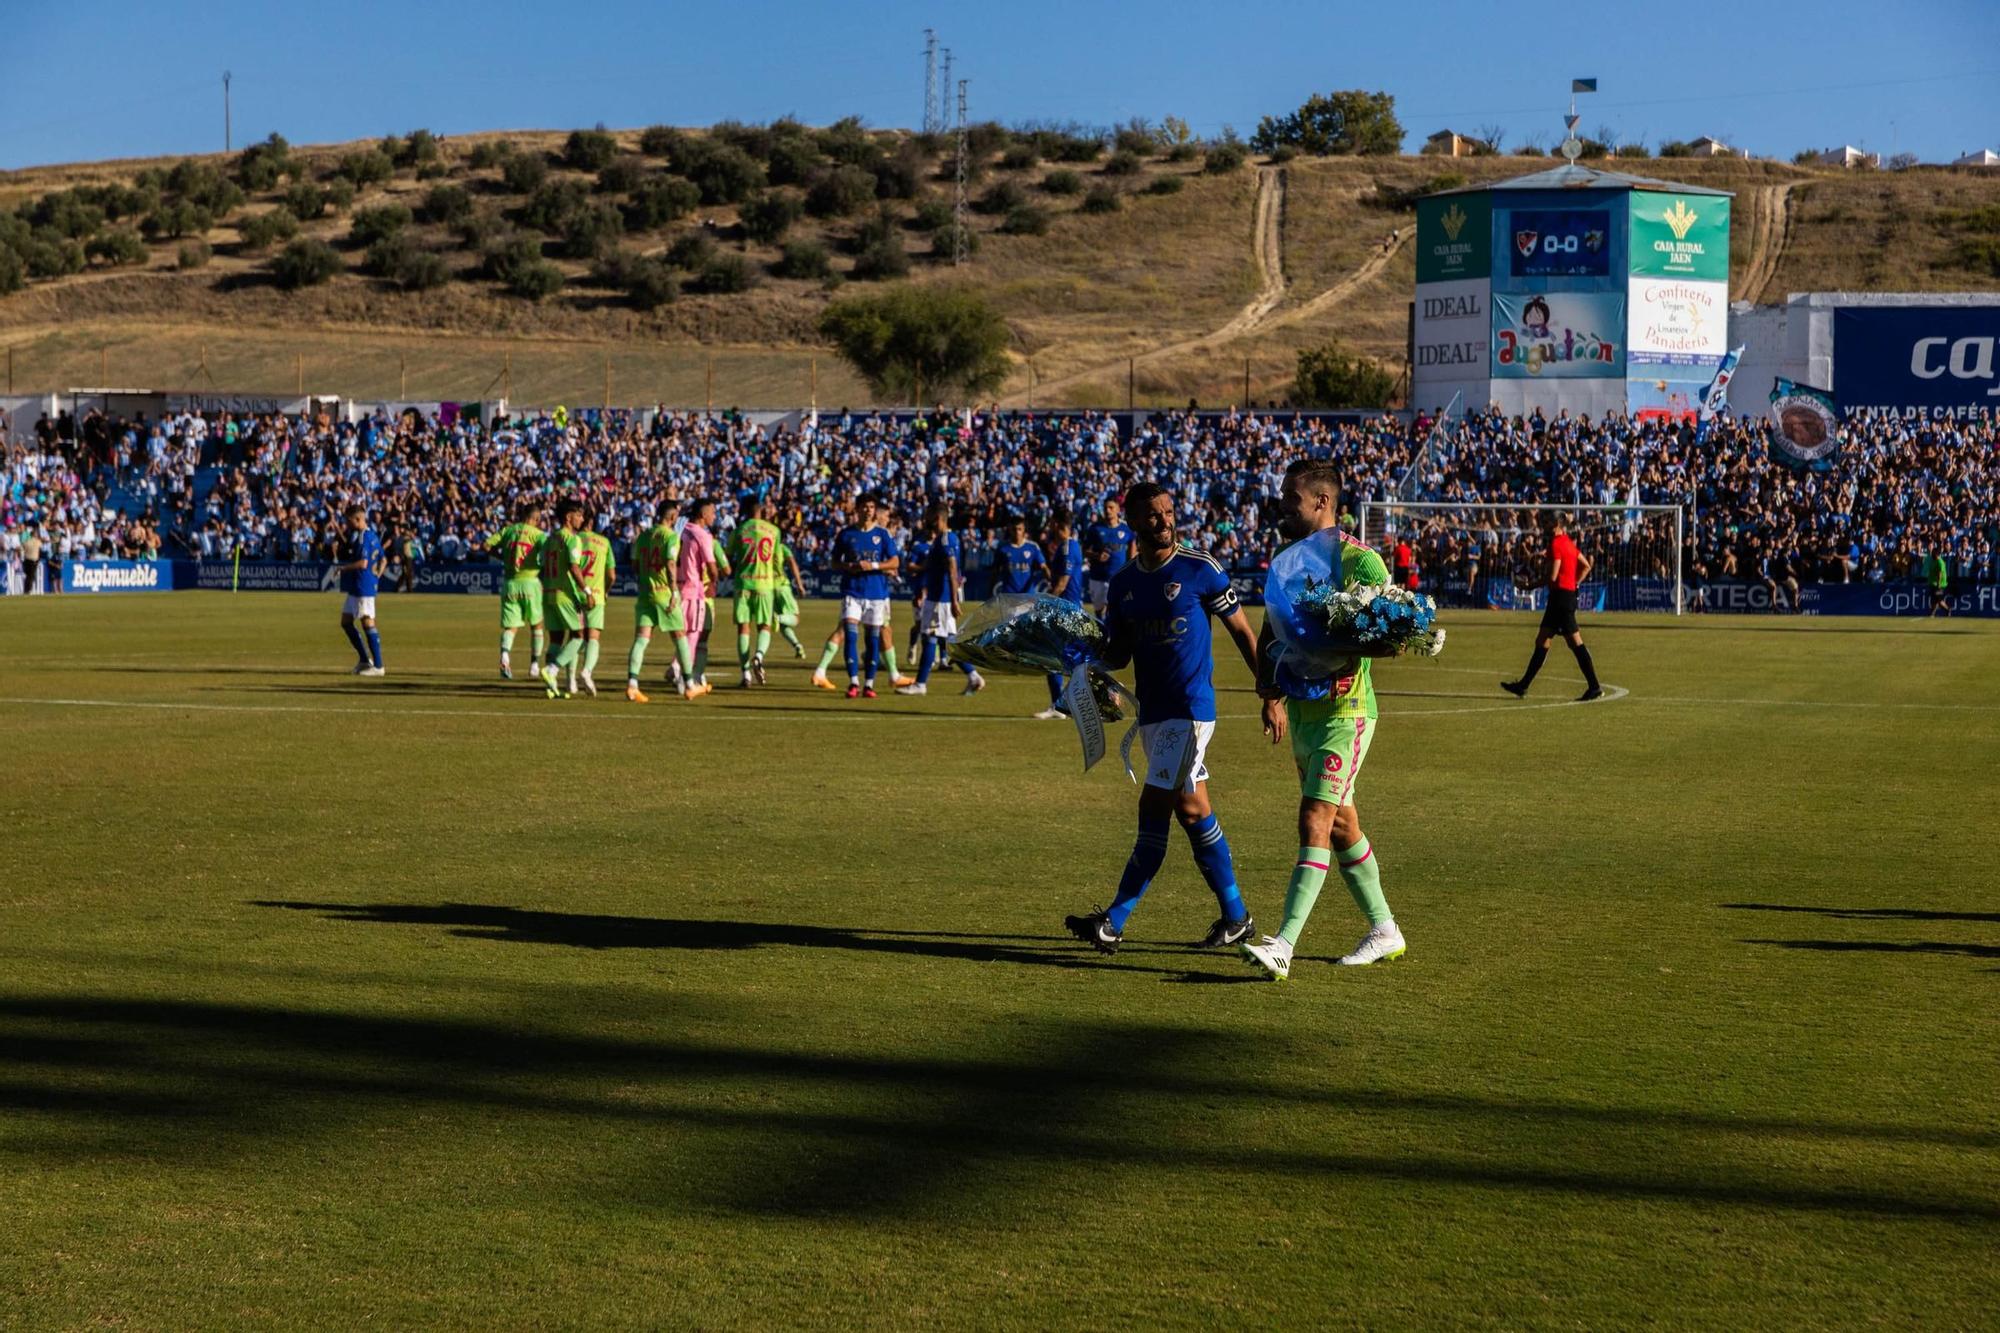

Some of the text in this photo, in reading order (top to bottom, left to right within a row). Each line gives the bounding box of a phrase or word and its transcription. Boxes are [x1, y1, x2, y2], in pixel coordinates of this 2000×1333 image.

[1544, 235, 1578, 253] 0-0
[1654, 240, 1704, 255] CAJA RURAL
[1423, 295, 1481, 319] IDEAL
[1662, 299, 1685, 312] Virgen
[1669, 313, 1677, 322] de
[1417, 343, 1478, 366] IDEAL
[232, 394, 278, 411] SABOR
[1844, 405, 1901, 420] VENTA
[1906, 405, 1928, 420] DE
[741, 537, 772, 562] 20
[72, 563, 158, 592] Rapimueble
[239, 566, 277, 577] GALIANO
[278, 566, 319, 578] CAÑADAS
[420, 568, 492, 588] Servega
[1226, 588, 1238, 605] C
[1670, 583, 1790, 608] ORTEGA
[1072, 680, 1092, 735] DEPORTIVA
[1080, 687, 1098, 728] LEONES
